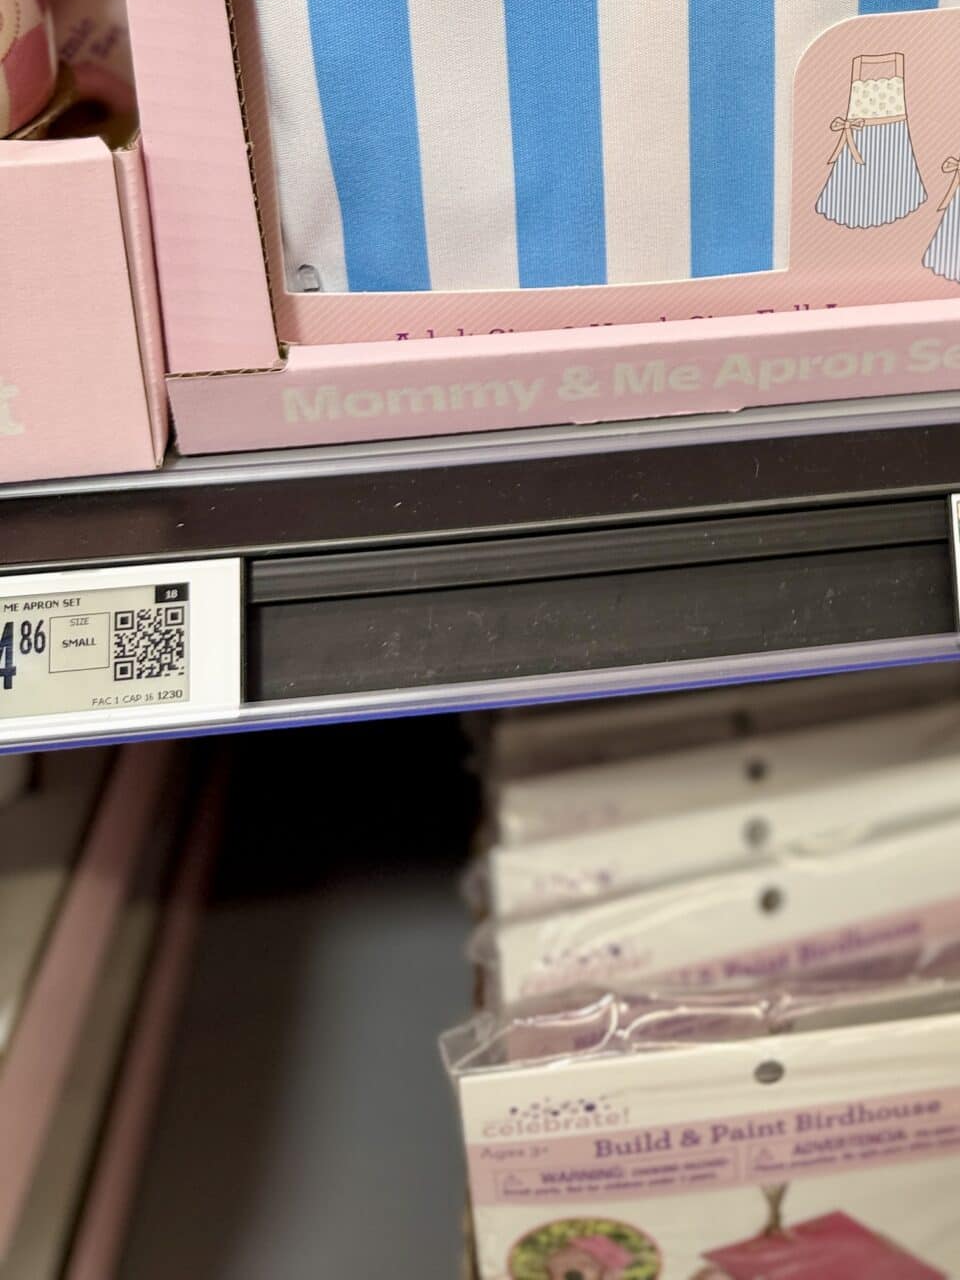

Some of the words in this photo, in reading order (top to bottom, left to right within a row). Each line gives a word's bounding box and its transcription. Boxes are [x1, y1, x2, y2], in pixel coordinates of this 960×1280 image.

[280, 376, 546, 423] Mommy
[558, 366, 600, 402] &
[612, 357, 700, 397] Me
[713, 348, 896, 392] Apron
[4, 602, 20, 613] ME
[23, 600, 59, 611] APRON
[62, 597, 82, 608] SET
[69, 617, 90, 627] SIZE
[62, 637, 96, 649] SMALL
[157, 689, 183, 700] 1230
[593, 1129, 672, 1159] Build
[679, 1128, 700, 1148] &
[710, 1116, 787, 1145] Paint
[794, 1098, 942, 1134] Birdhouse
